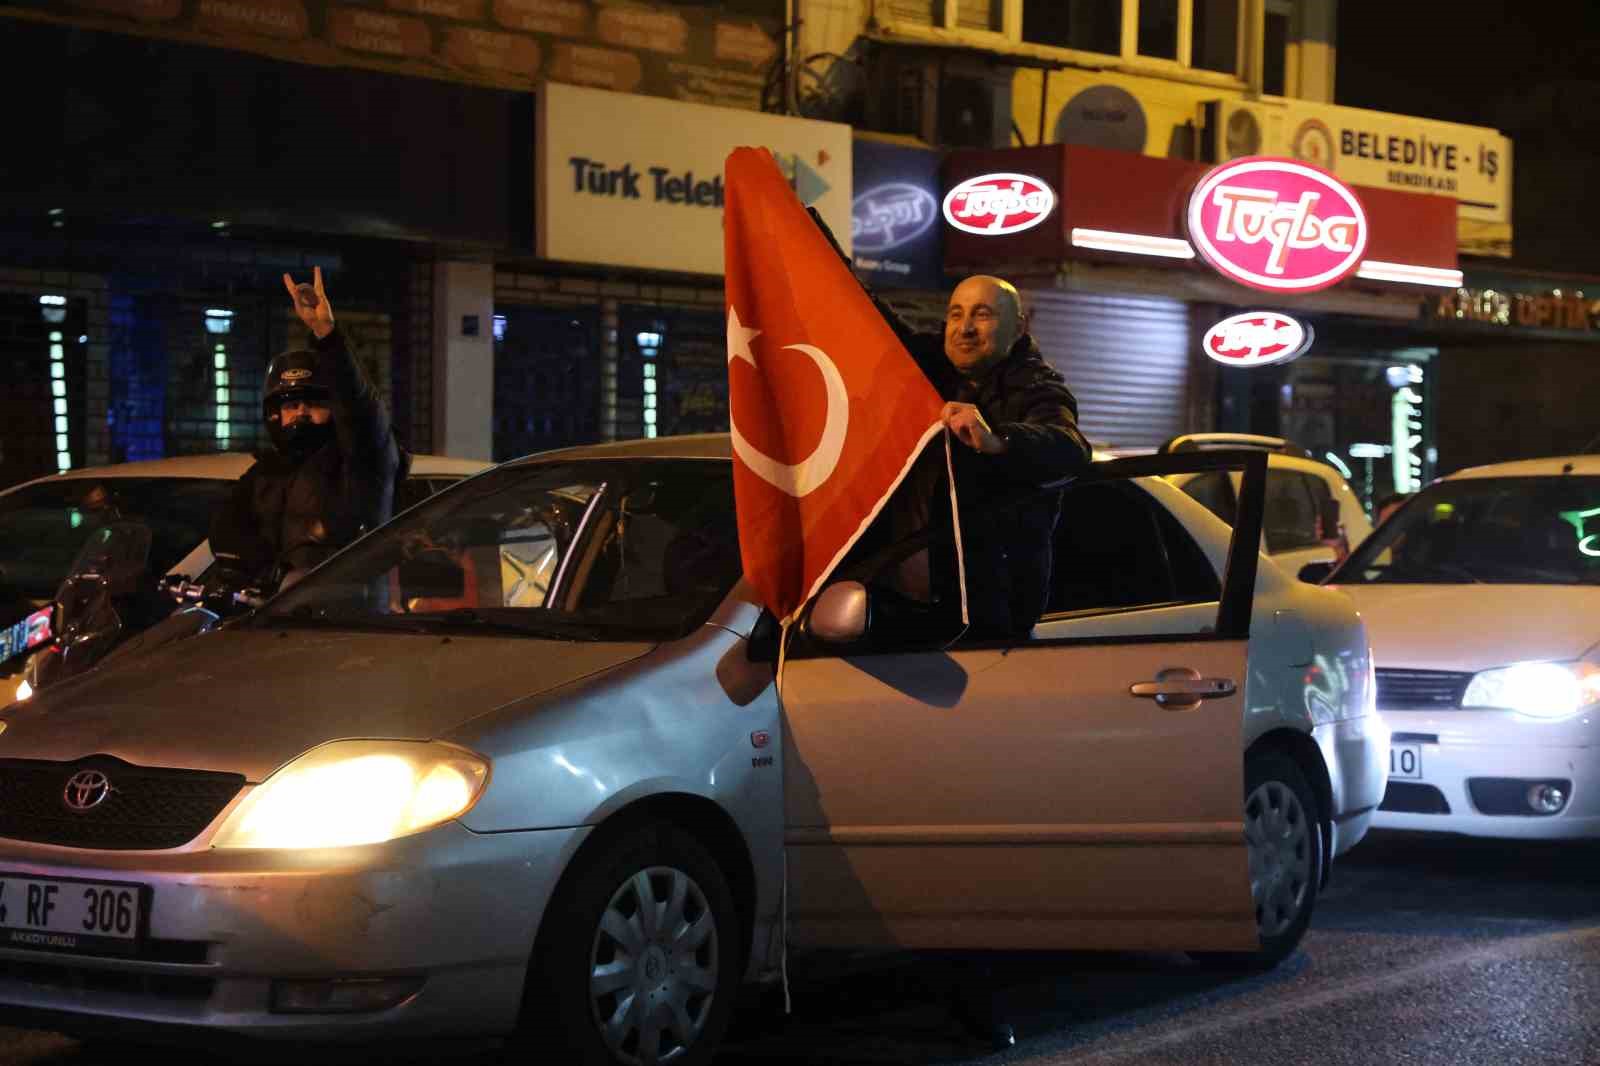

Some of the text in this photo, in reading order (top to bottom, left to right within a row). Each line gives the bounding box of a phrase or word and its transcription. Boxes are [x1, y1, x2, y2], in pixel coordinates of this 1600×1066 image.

[1341, 129, 1457, 171] BELEDİYE
[569, 156, 642, 199] Türk
[27, 884, 59, 927] RF
[82, 888, 132, 933] 306
